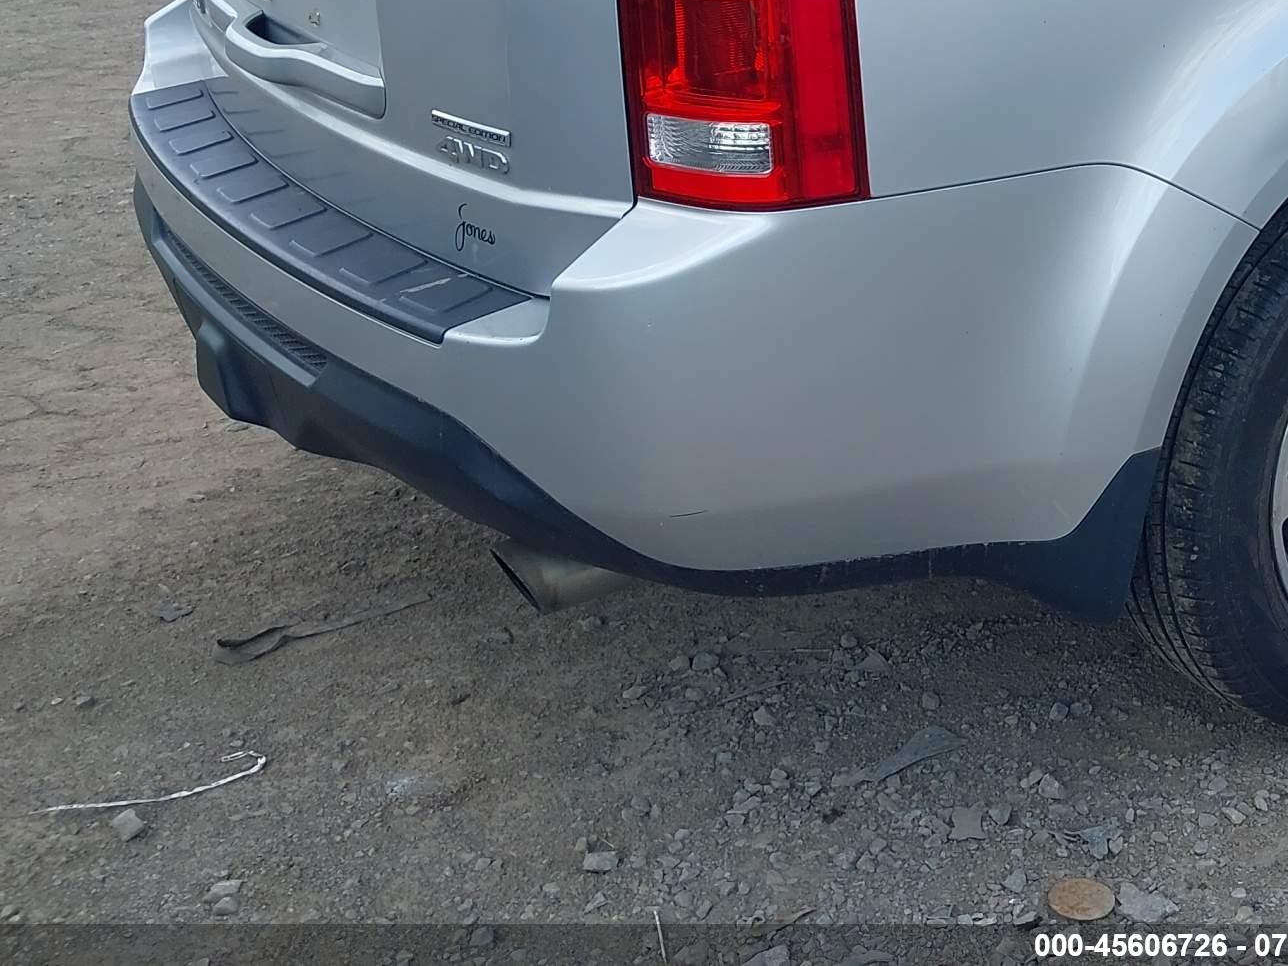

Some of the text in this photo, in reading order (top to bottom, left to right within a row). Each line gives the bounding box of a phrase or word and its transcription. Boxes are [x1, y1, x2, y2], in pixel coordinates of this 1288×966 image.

[431, 114, 506, 143] SPECIAL EDITION
[437, 136, 510, 175] 4WD
